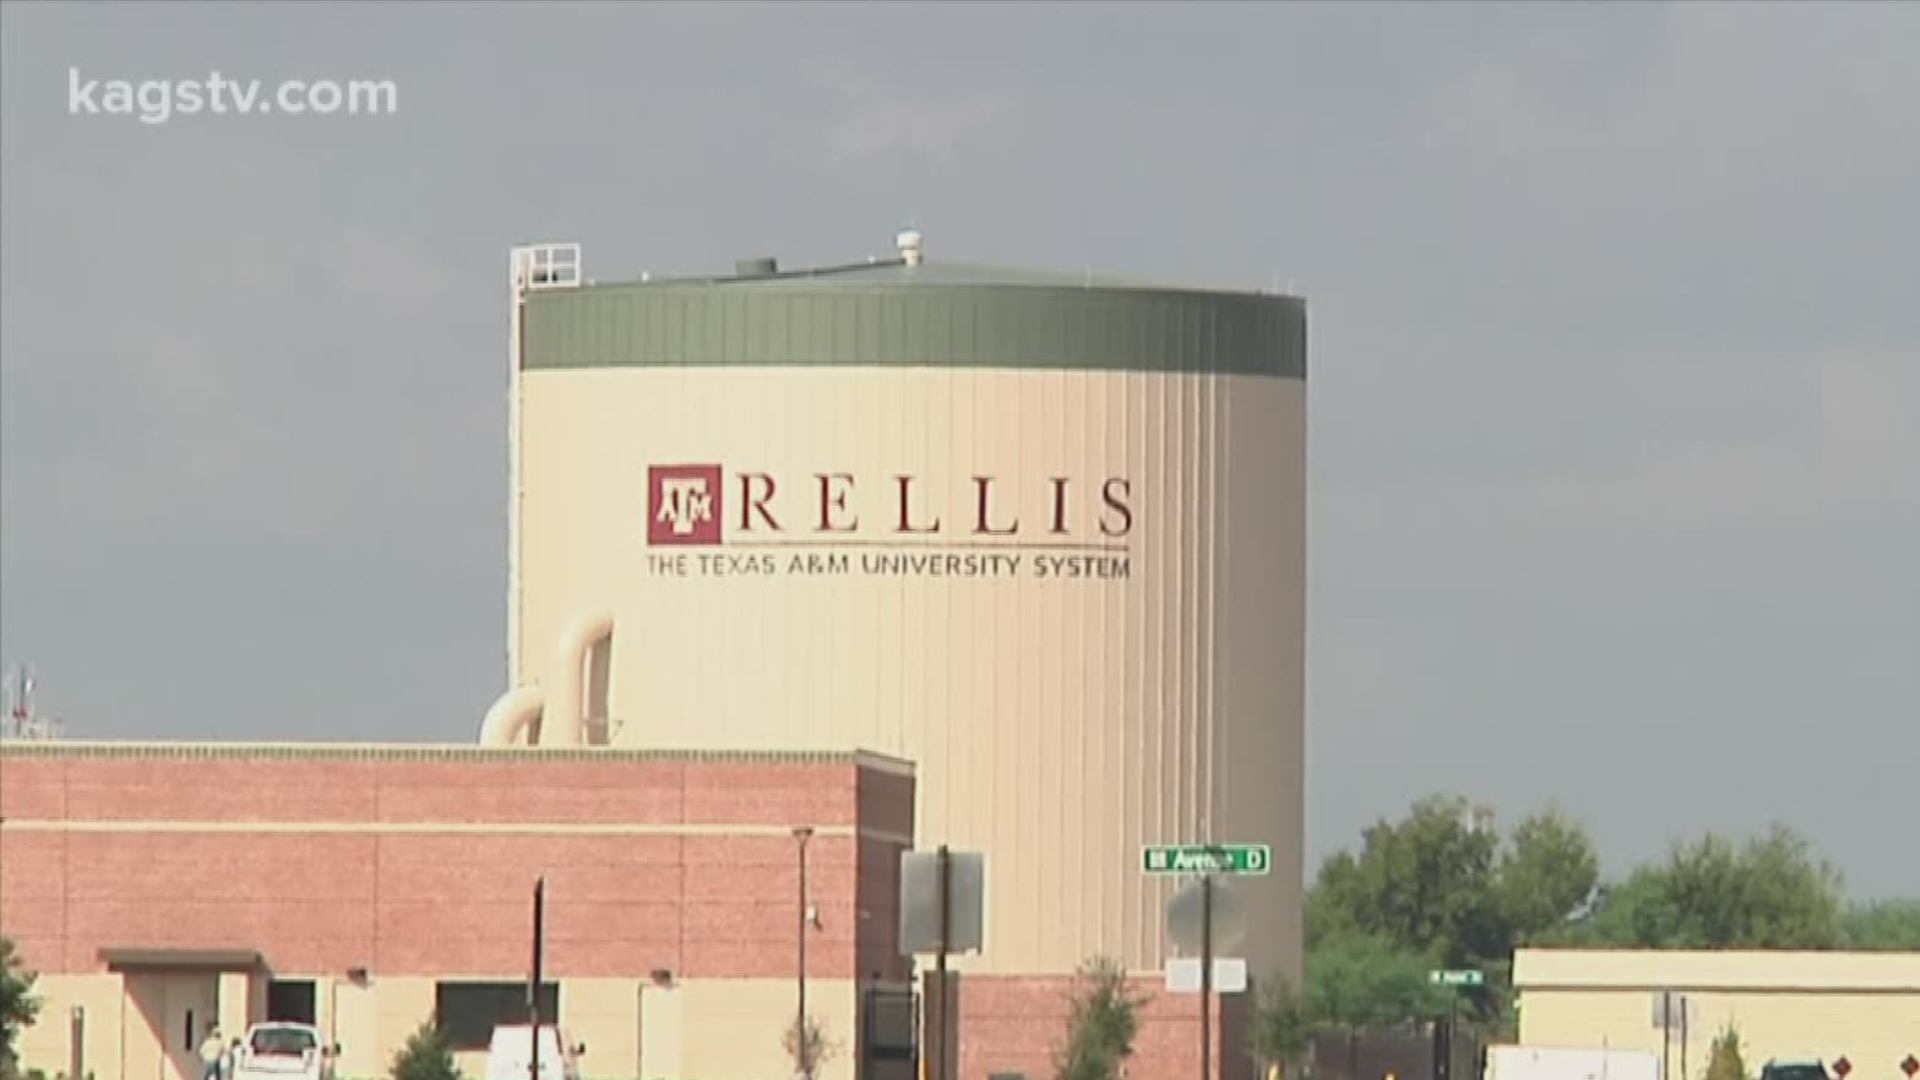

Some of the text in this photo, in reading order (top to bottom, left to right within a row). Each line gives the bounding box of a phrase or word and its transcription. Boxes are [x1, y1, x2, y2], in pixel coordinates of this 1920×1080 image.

[735, 472, 1133, 537] RELLIS
[647, 554, 1131, 579] THE TEXAS A&M UNIVERSITY SYSTEM
[1173, 850, 1234, 871] Avene
[1246, 850, 1262, 869] D
